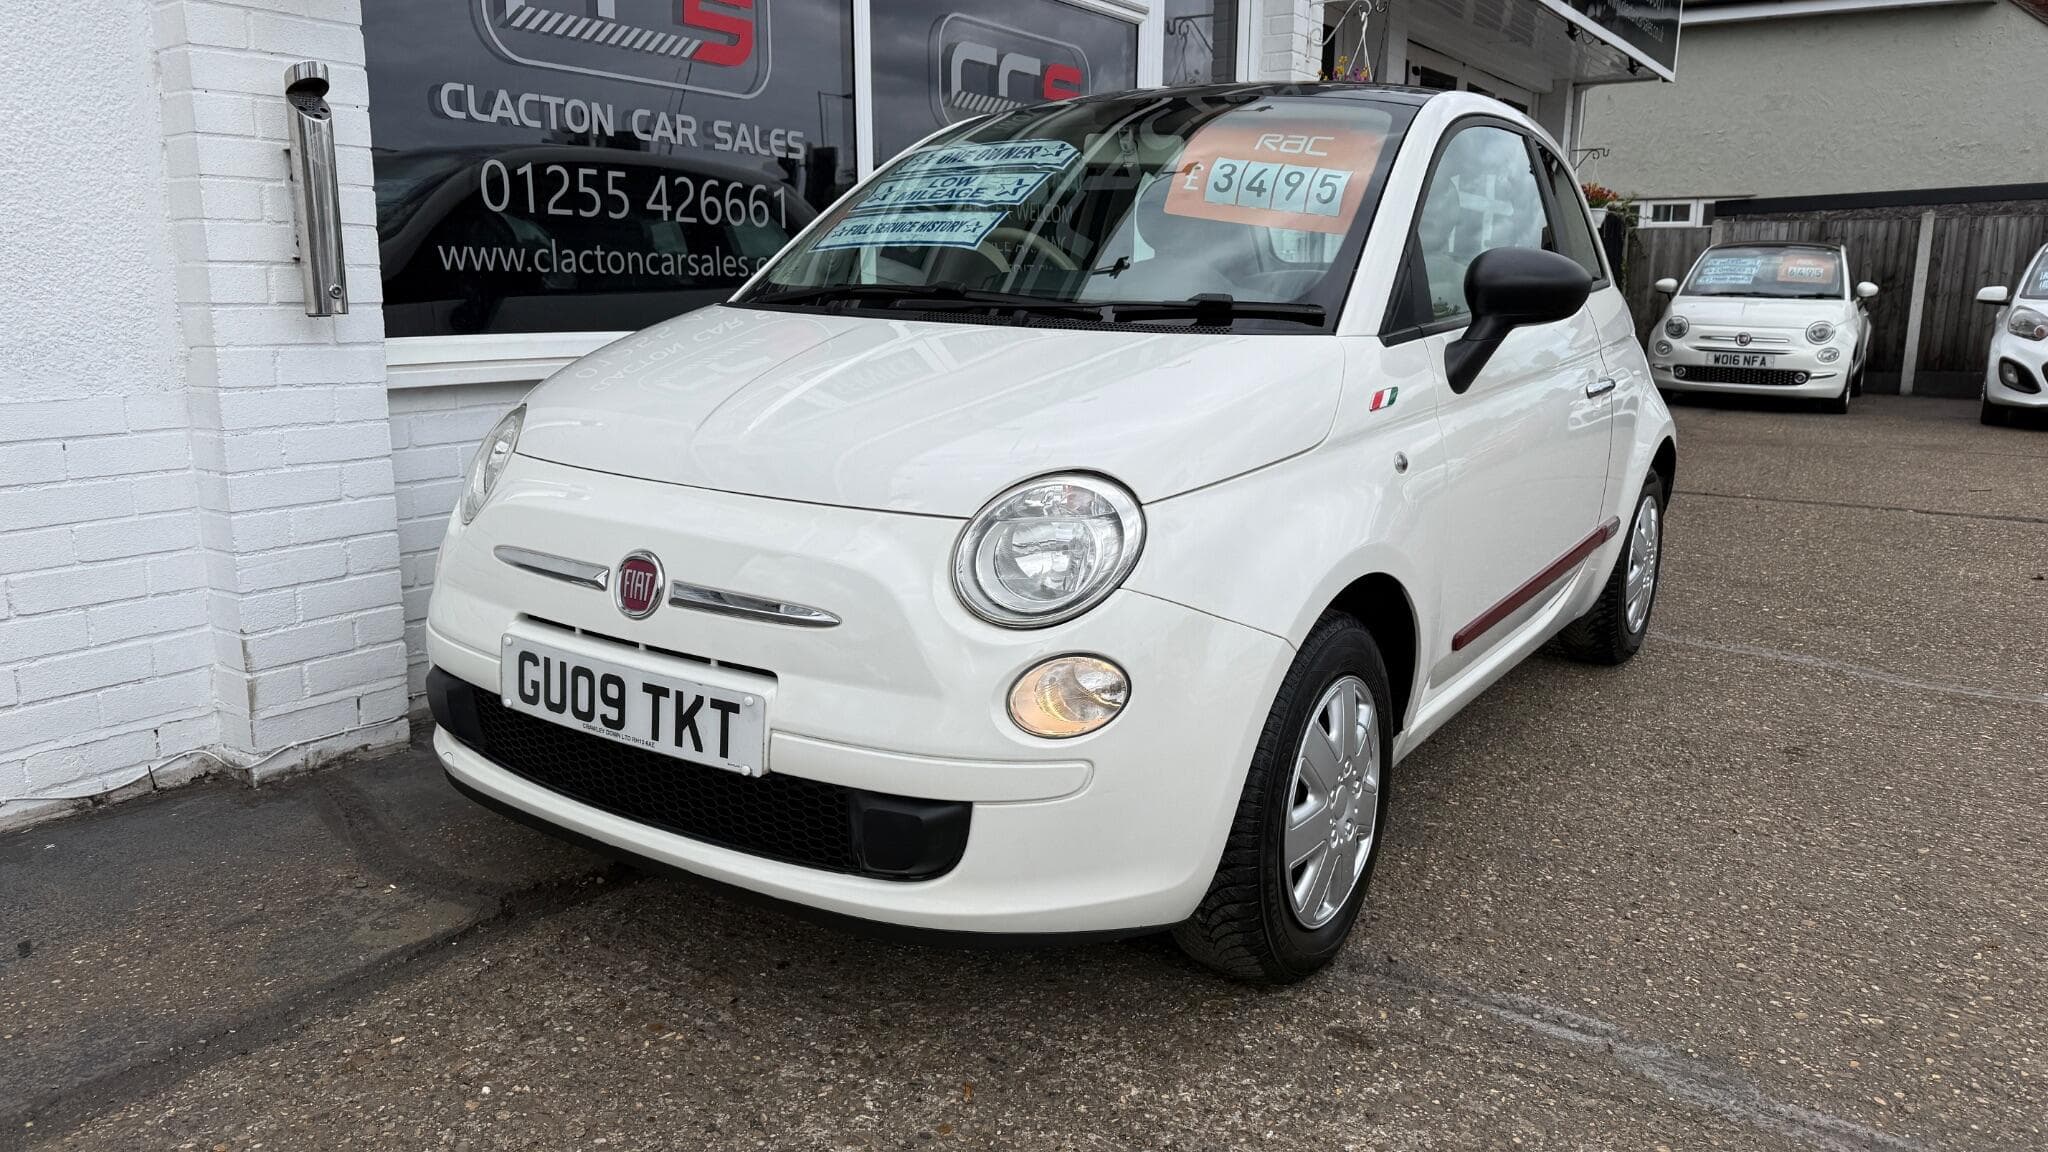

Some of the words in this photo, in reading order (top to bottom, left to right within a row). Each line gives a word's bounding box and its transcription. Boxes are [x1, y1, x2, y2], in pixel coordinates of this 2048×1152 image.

[440, 83, 614, 138] CLACTON
[631, 108, 698, 148] CAR
[713, 120, 805, 161] SALES
[936, 149, 974, 165] ONE
[974, 146, 1041, 162] OWNER
[480, 158, 629, 220] 01255
[646, 177, 789, 229] 426661
[896, 187, 989, 202] MILEAGE
[928, 176, 978, 189] LOW
[1213, 163, 1343, 204] 3495
[845, 221, 868, 236] FULL
[870, 220, 918, 235] SERVICE
[918, 219, 967, 234] HISTORY
[1714, 353, 1740, 366] WO16
[1743, 355, 1767, 367] NFA
[622, 568, 653, 602] FIAT
[518, 650, 627, 732] GU09
[642, 682, 741, 760] TKT
